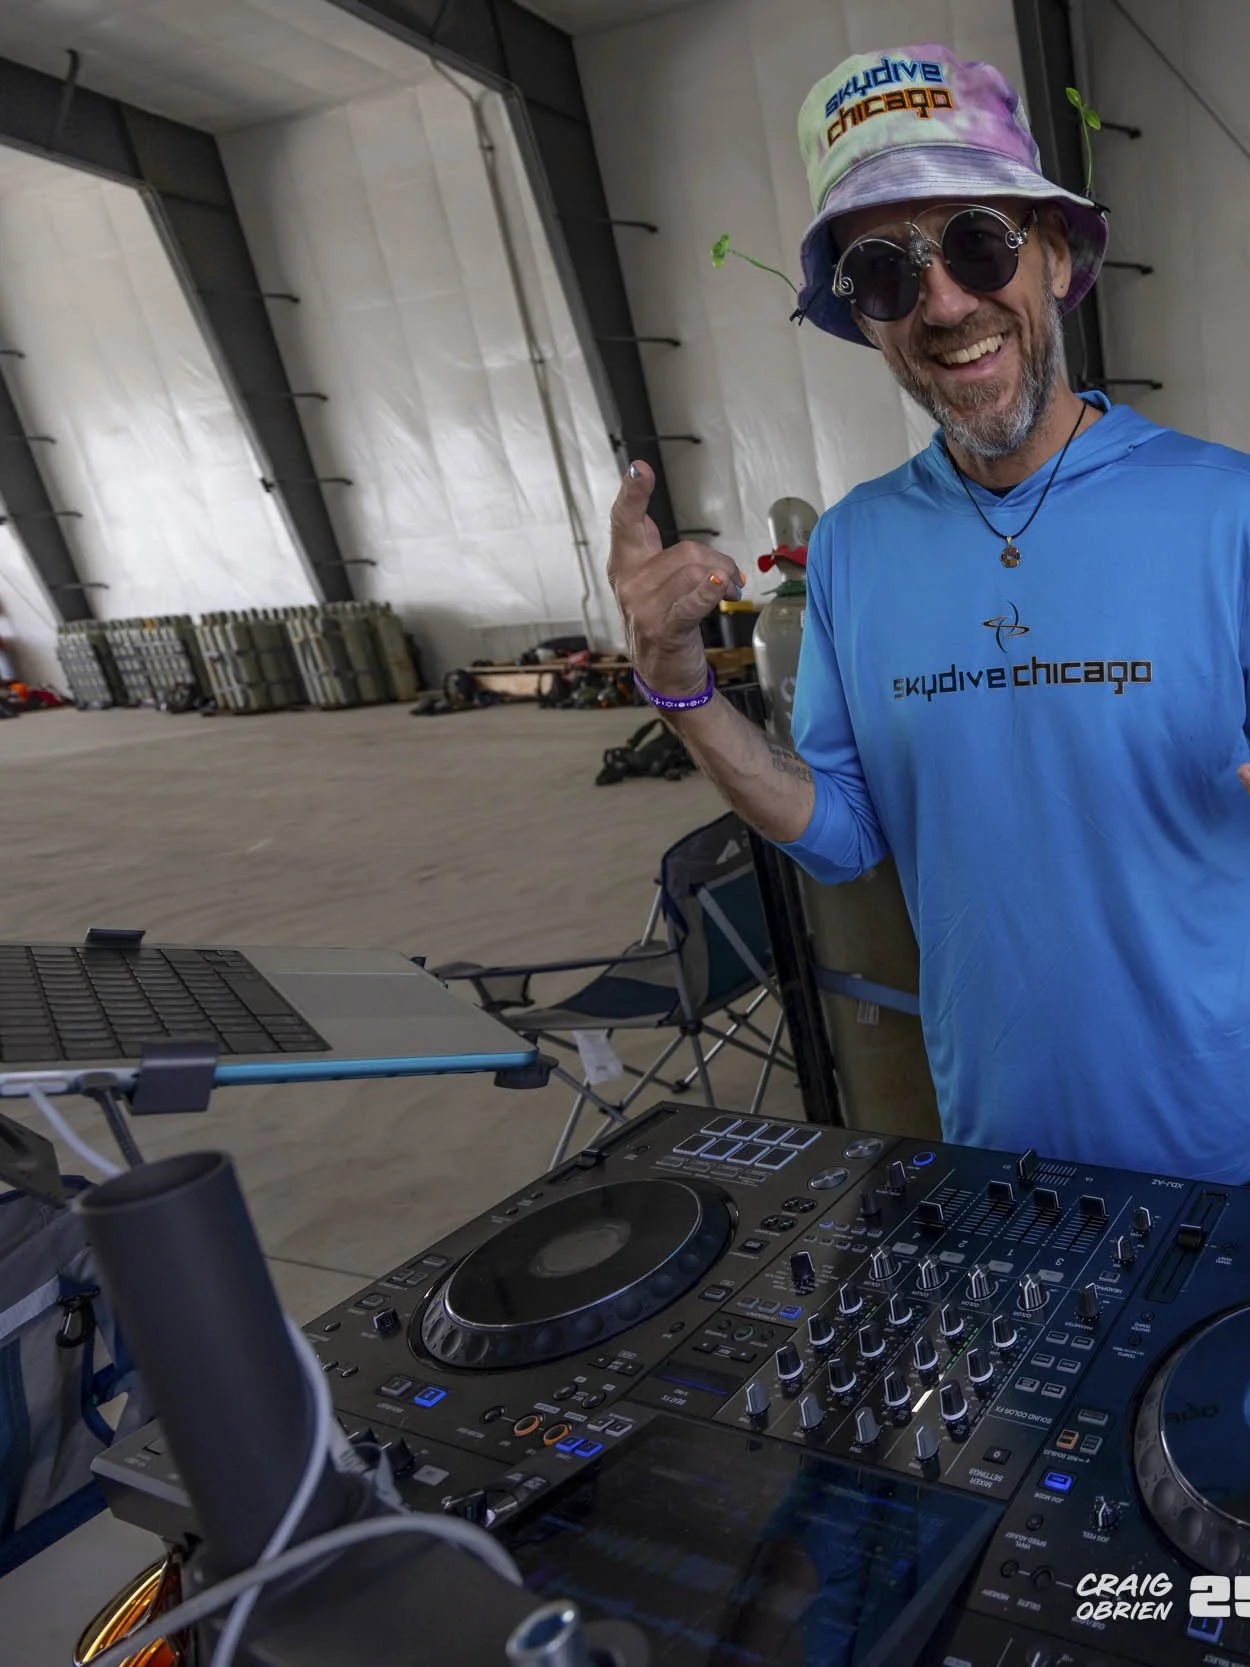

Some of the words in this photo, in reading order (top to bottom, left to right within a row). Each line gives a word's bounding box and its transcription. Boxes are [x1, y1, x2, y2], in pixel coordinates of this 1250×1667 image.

[825, 56, 944, 118] skydive
[827, 87, 955, 147] chicago
[893, 664, 1006, 702] skydive
[1012, 656, 1152, 696] chicago
[1055, 1257, 1064, 1265] 3
[1004, 1407, 1027, 1419] COLOR
[1029, 1413, 1051, 1423] SOUND
[969, 1467, 1003, 1481] SETTINGS
[969, 1477, 992, 1487] MIXER
